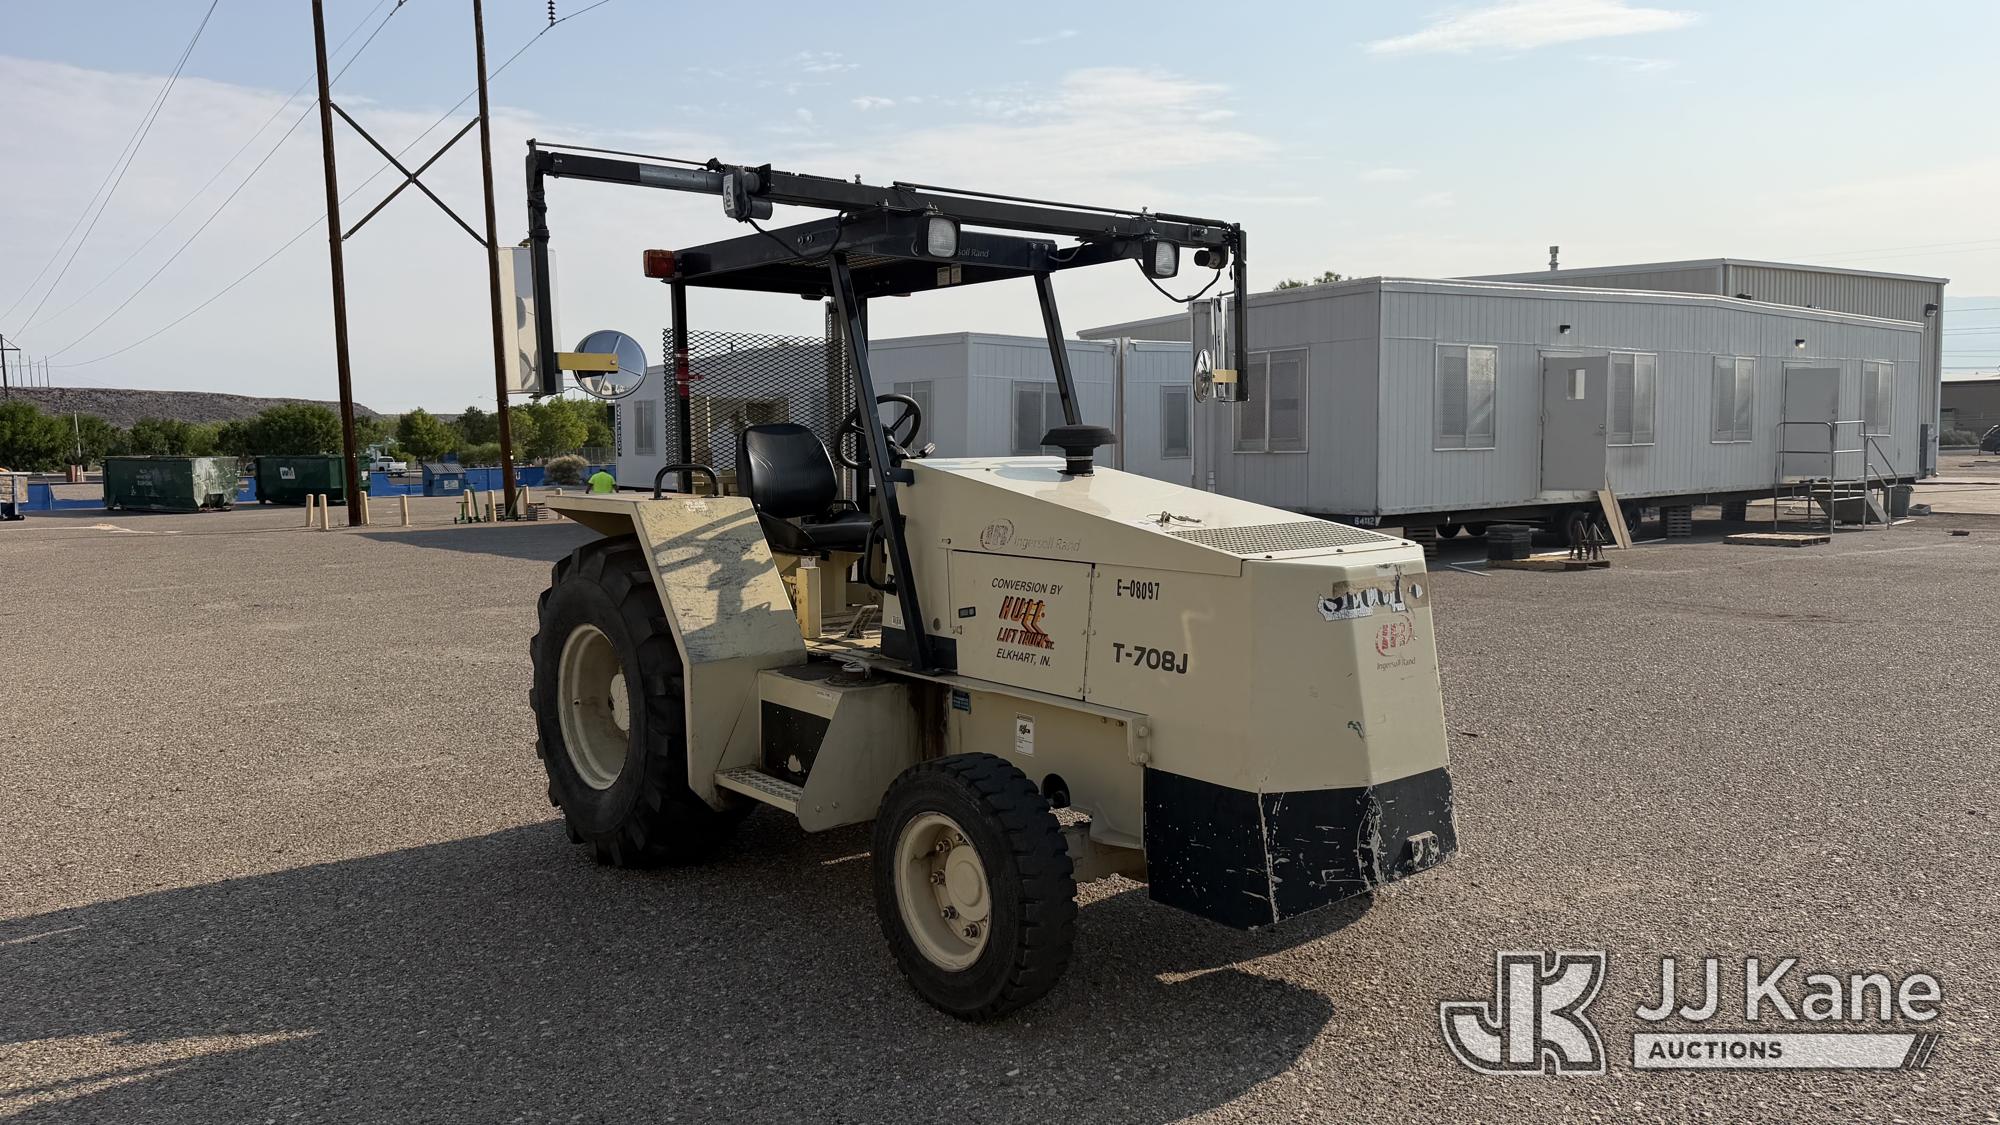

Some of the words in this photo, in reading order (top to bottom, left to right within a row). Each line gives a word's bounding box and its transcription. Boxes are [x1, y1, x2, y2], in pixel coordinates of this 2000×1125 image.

[992, 577, 1048, 593] CONVERSION
[1050, 584, 1064, 595] BY
[1117, 579, 1160, 600] E-08097
[997, 627, 1018, 643] LIFT
[996, 648, 1037, 666] ELKHART,
[1040, 656, 1051, 667] IN.
[1113, 642, 1188, 674] T-708J
